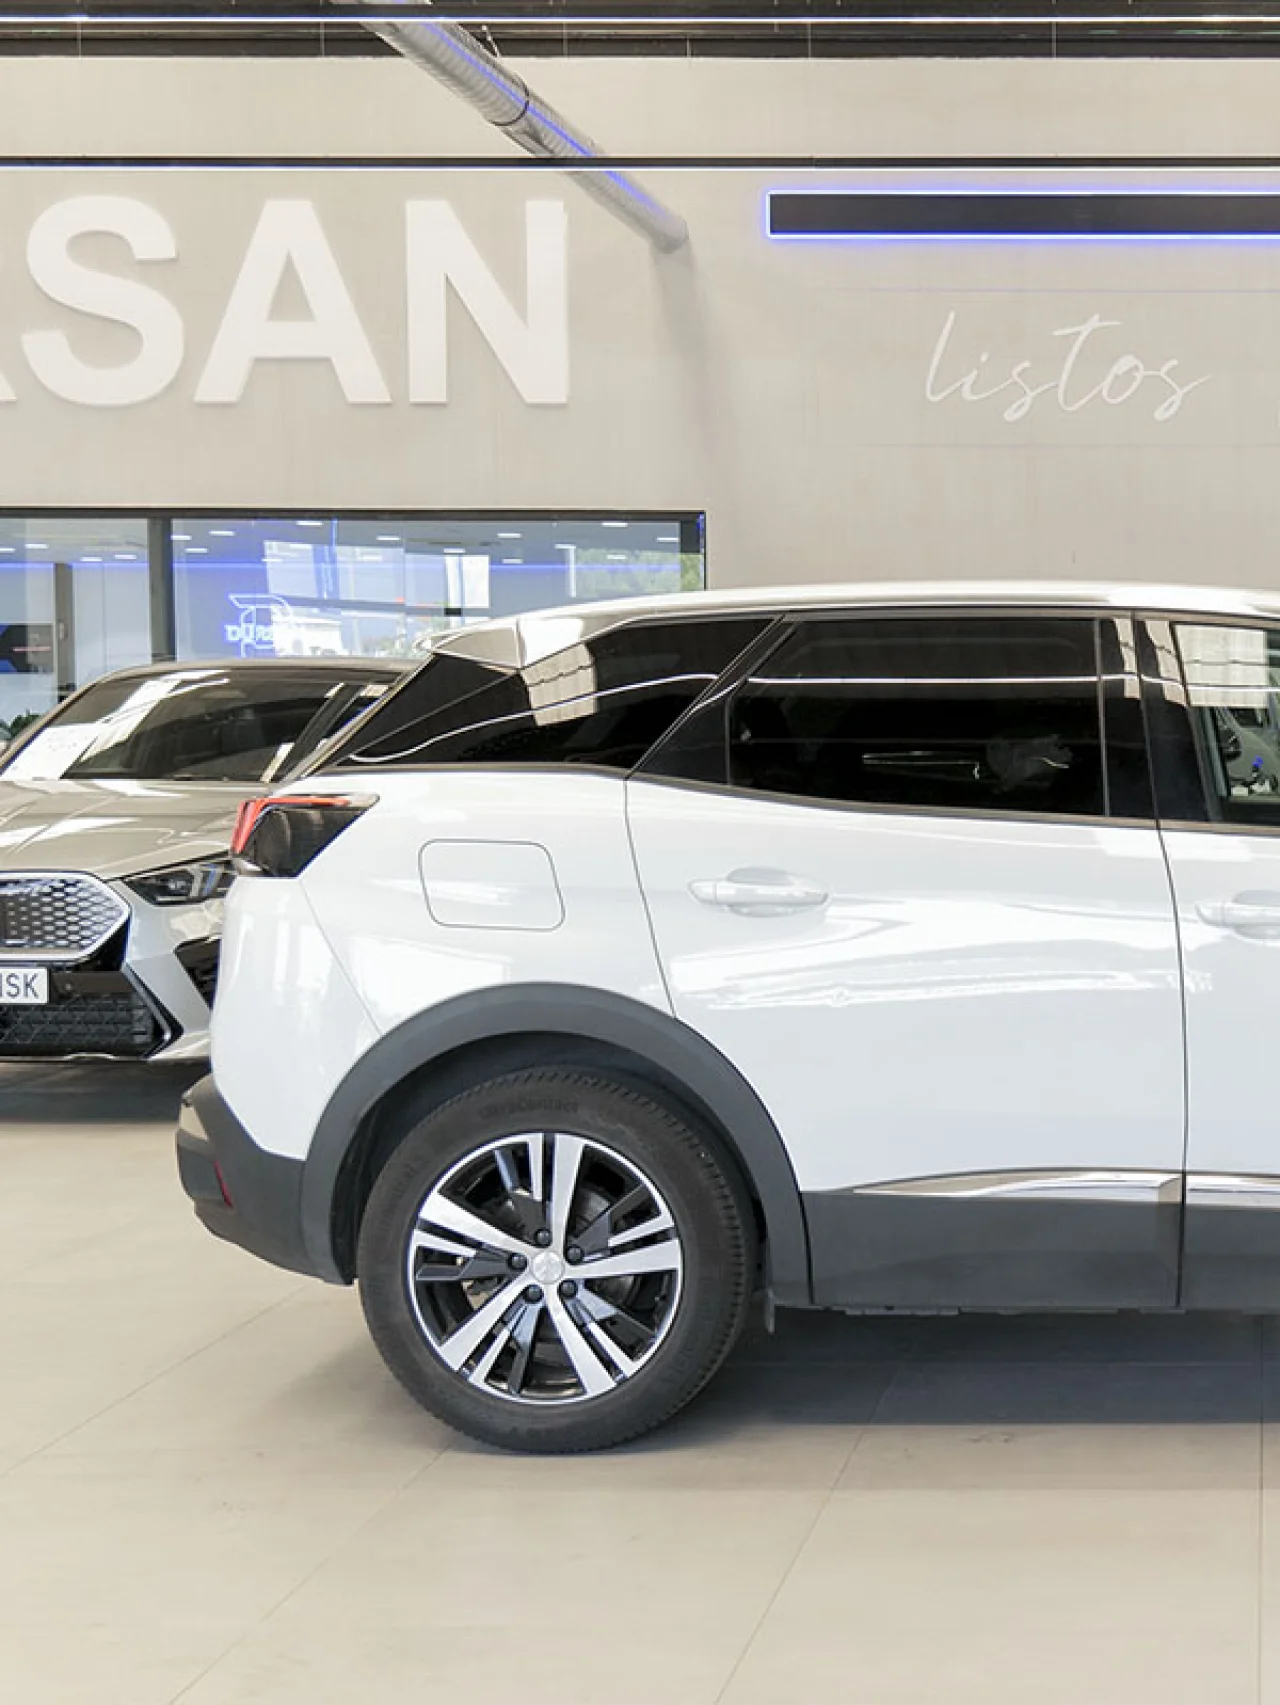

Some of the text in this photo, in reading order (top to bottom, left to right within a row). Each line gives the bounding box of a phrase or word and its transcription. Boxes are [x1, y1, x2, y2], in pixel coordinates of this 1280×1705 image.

[0, 195, 569, 406] SAN
[925, 310, 1212, 423] listos
[0, 972, 39, 1000] SK
